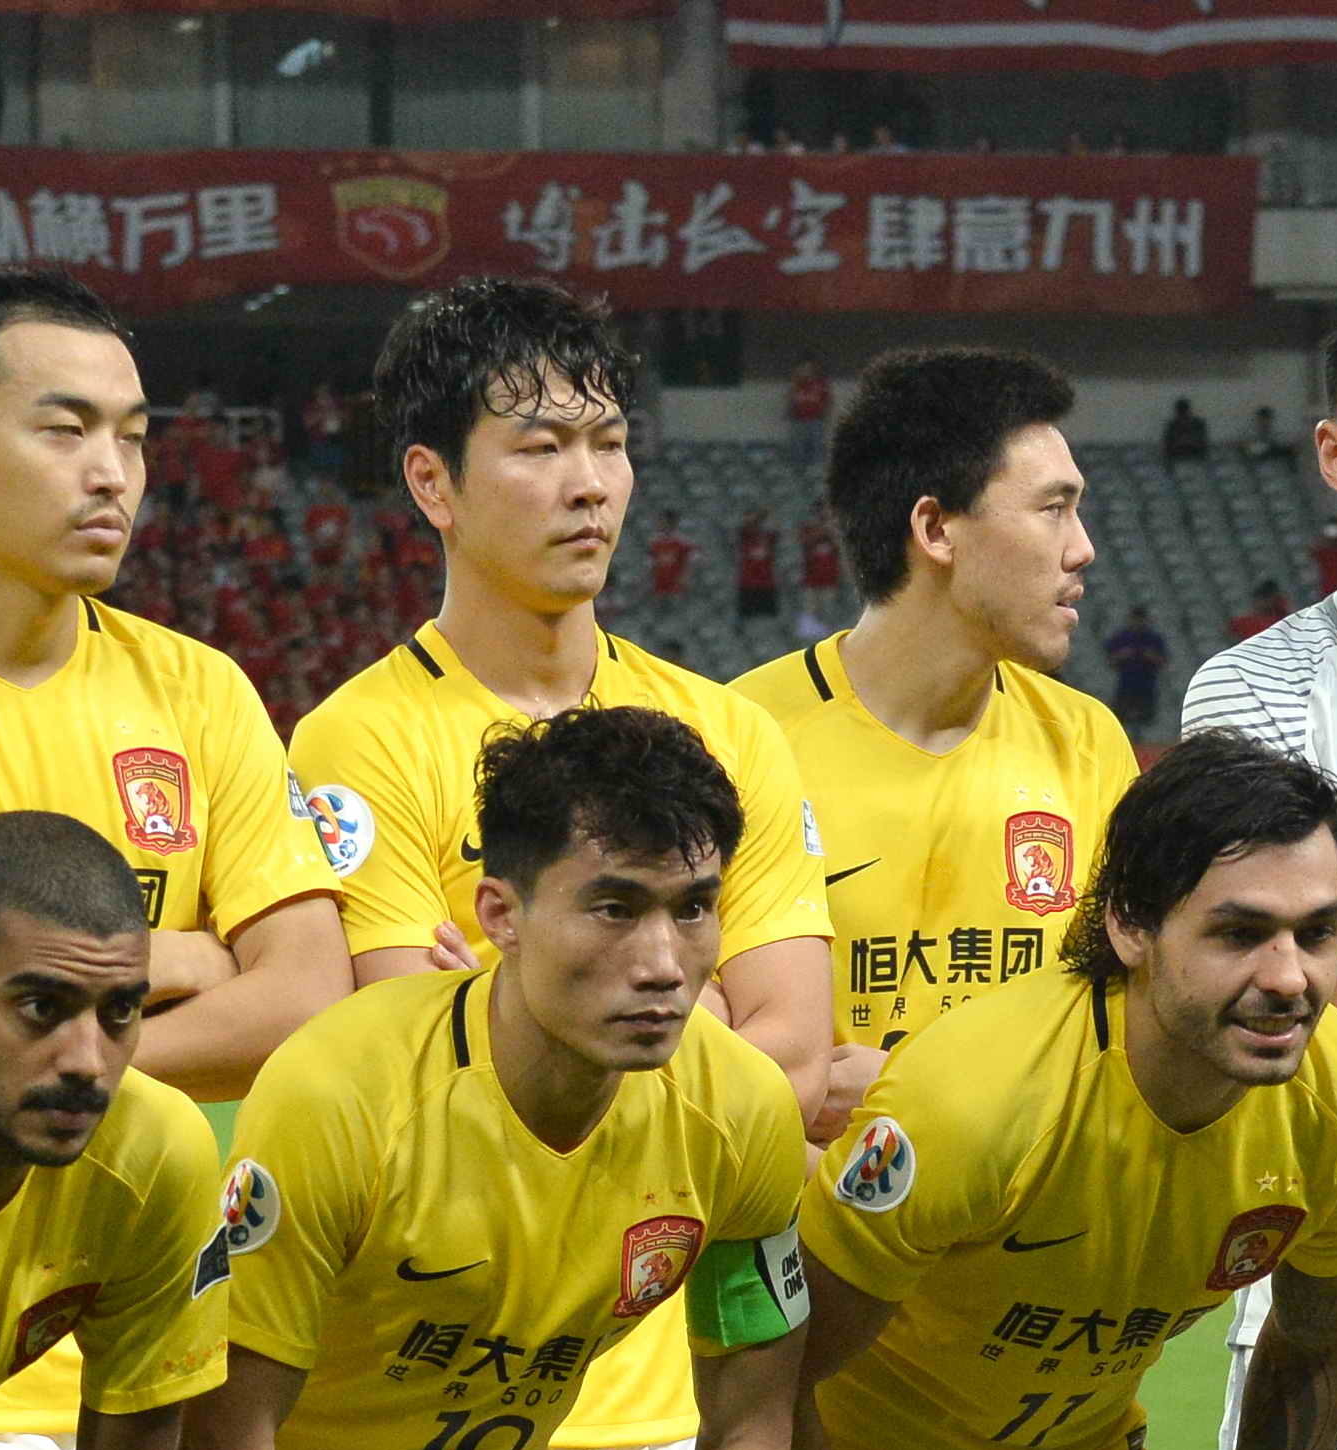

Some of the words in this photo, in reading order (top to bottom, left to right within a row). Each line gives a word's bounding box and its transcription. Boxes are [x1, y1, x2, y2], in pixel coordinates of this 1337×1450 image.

[850, 926, 1045, 994] 恒大集团
[990, 1391, 1097, 1448] 11
